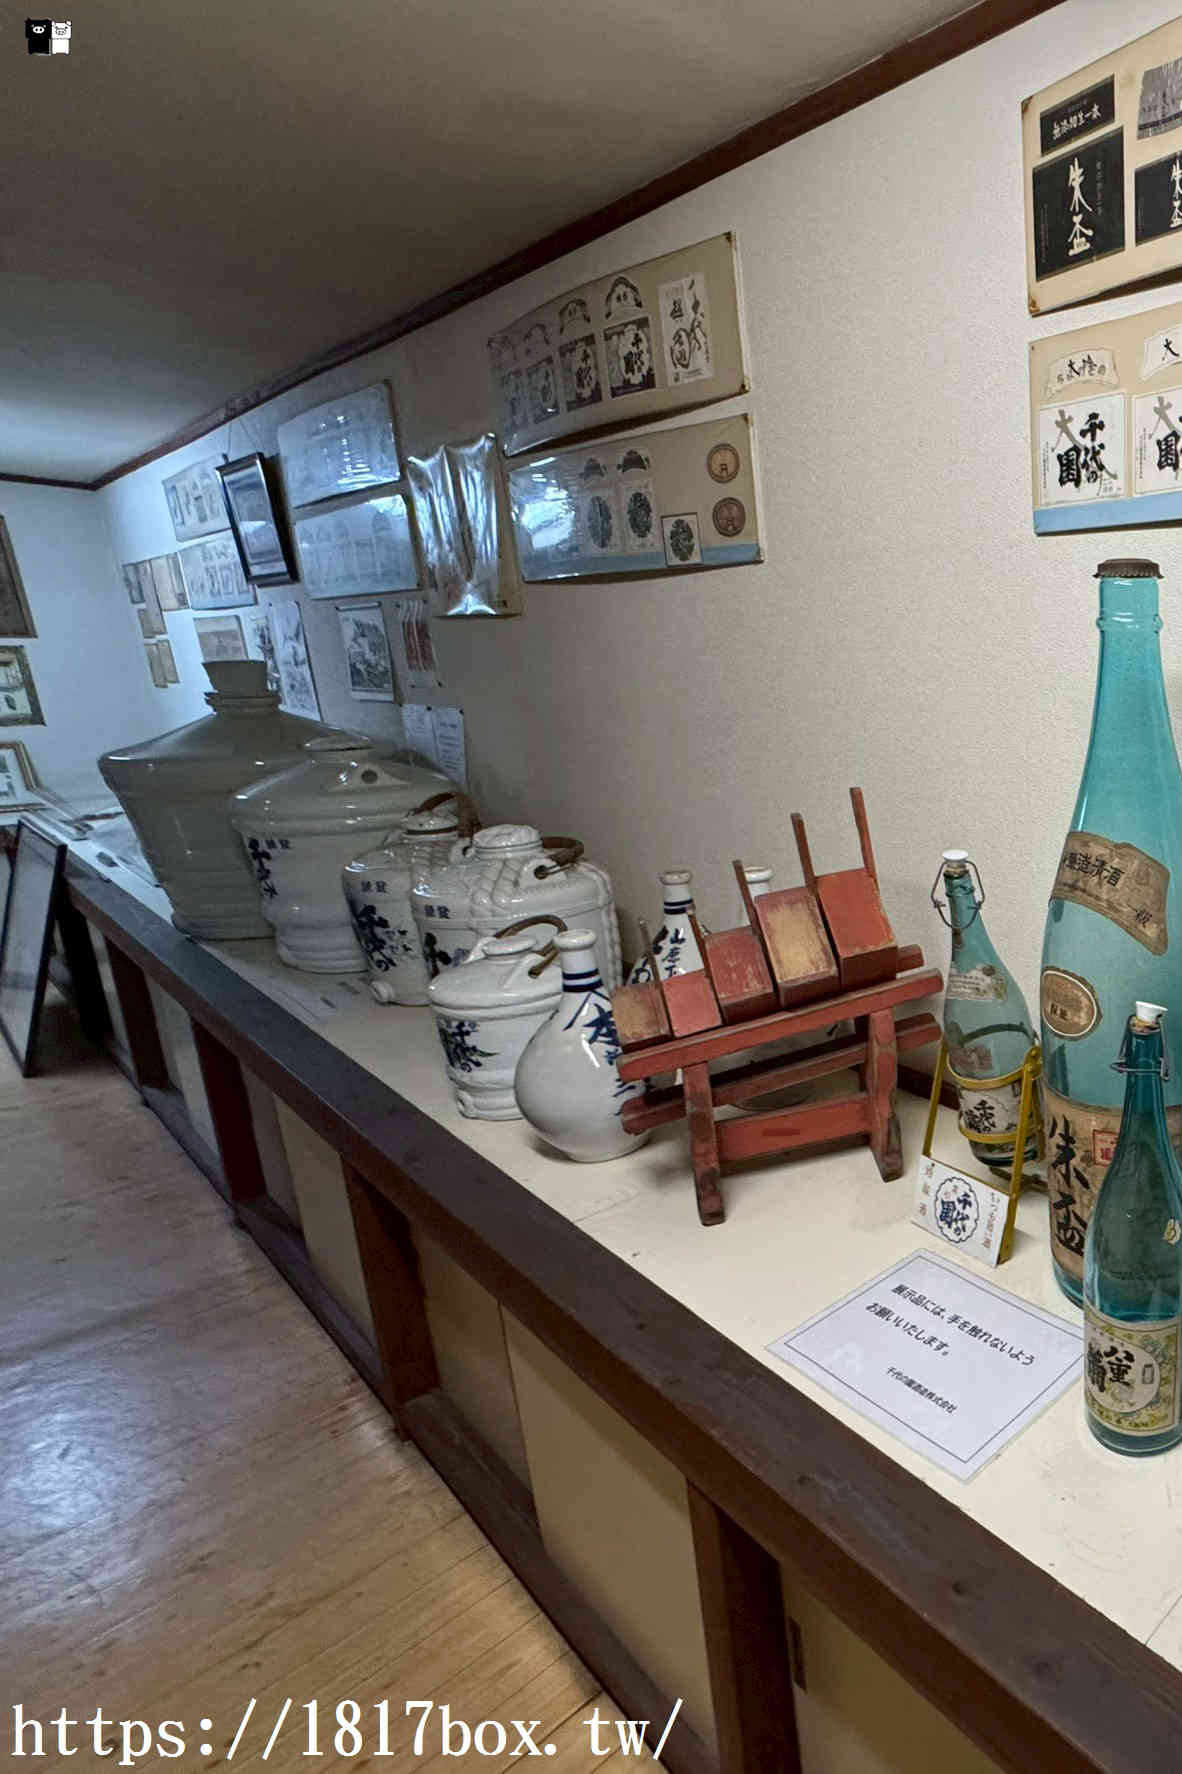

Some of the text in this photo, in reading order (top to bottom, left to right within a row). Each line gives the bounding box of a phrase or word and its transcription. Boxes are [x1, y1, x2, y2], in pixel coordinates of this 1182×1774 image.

[865, 1301, 949, 1357] お願いいたします。
[891, 1283, 1036, 1366] 展示品には、手を触れないよう
